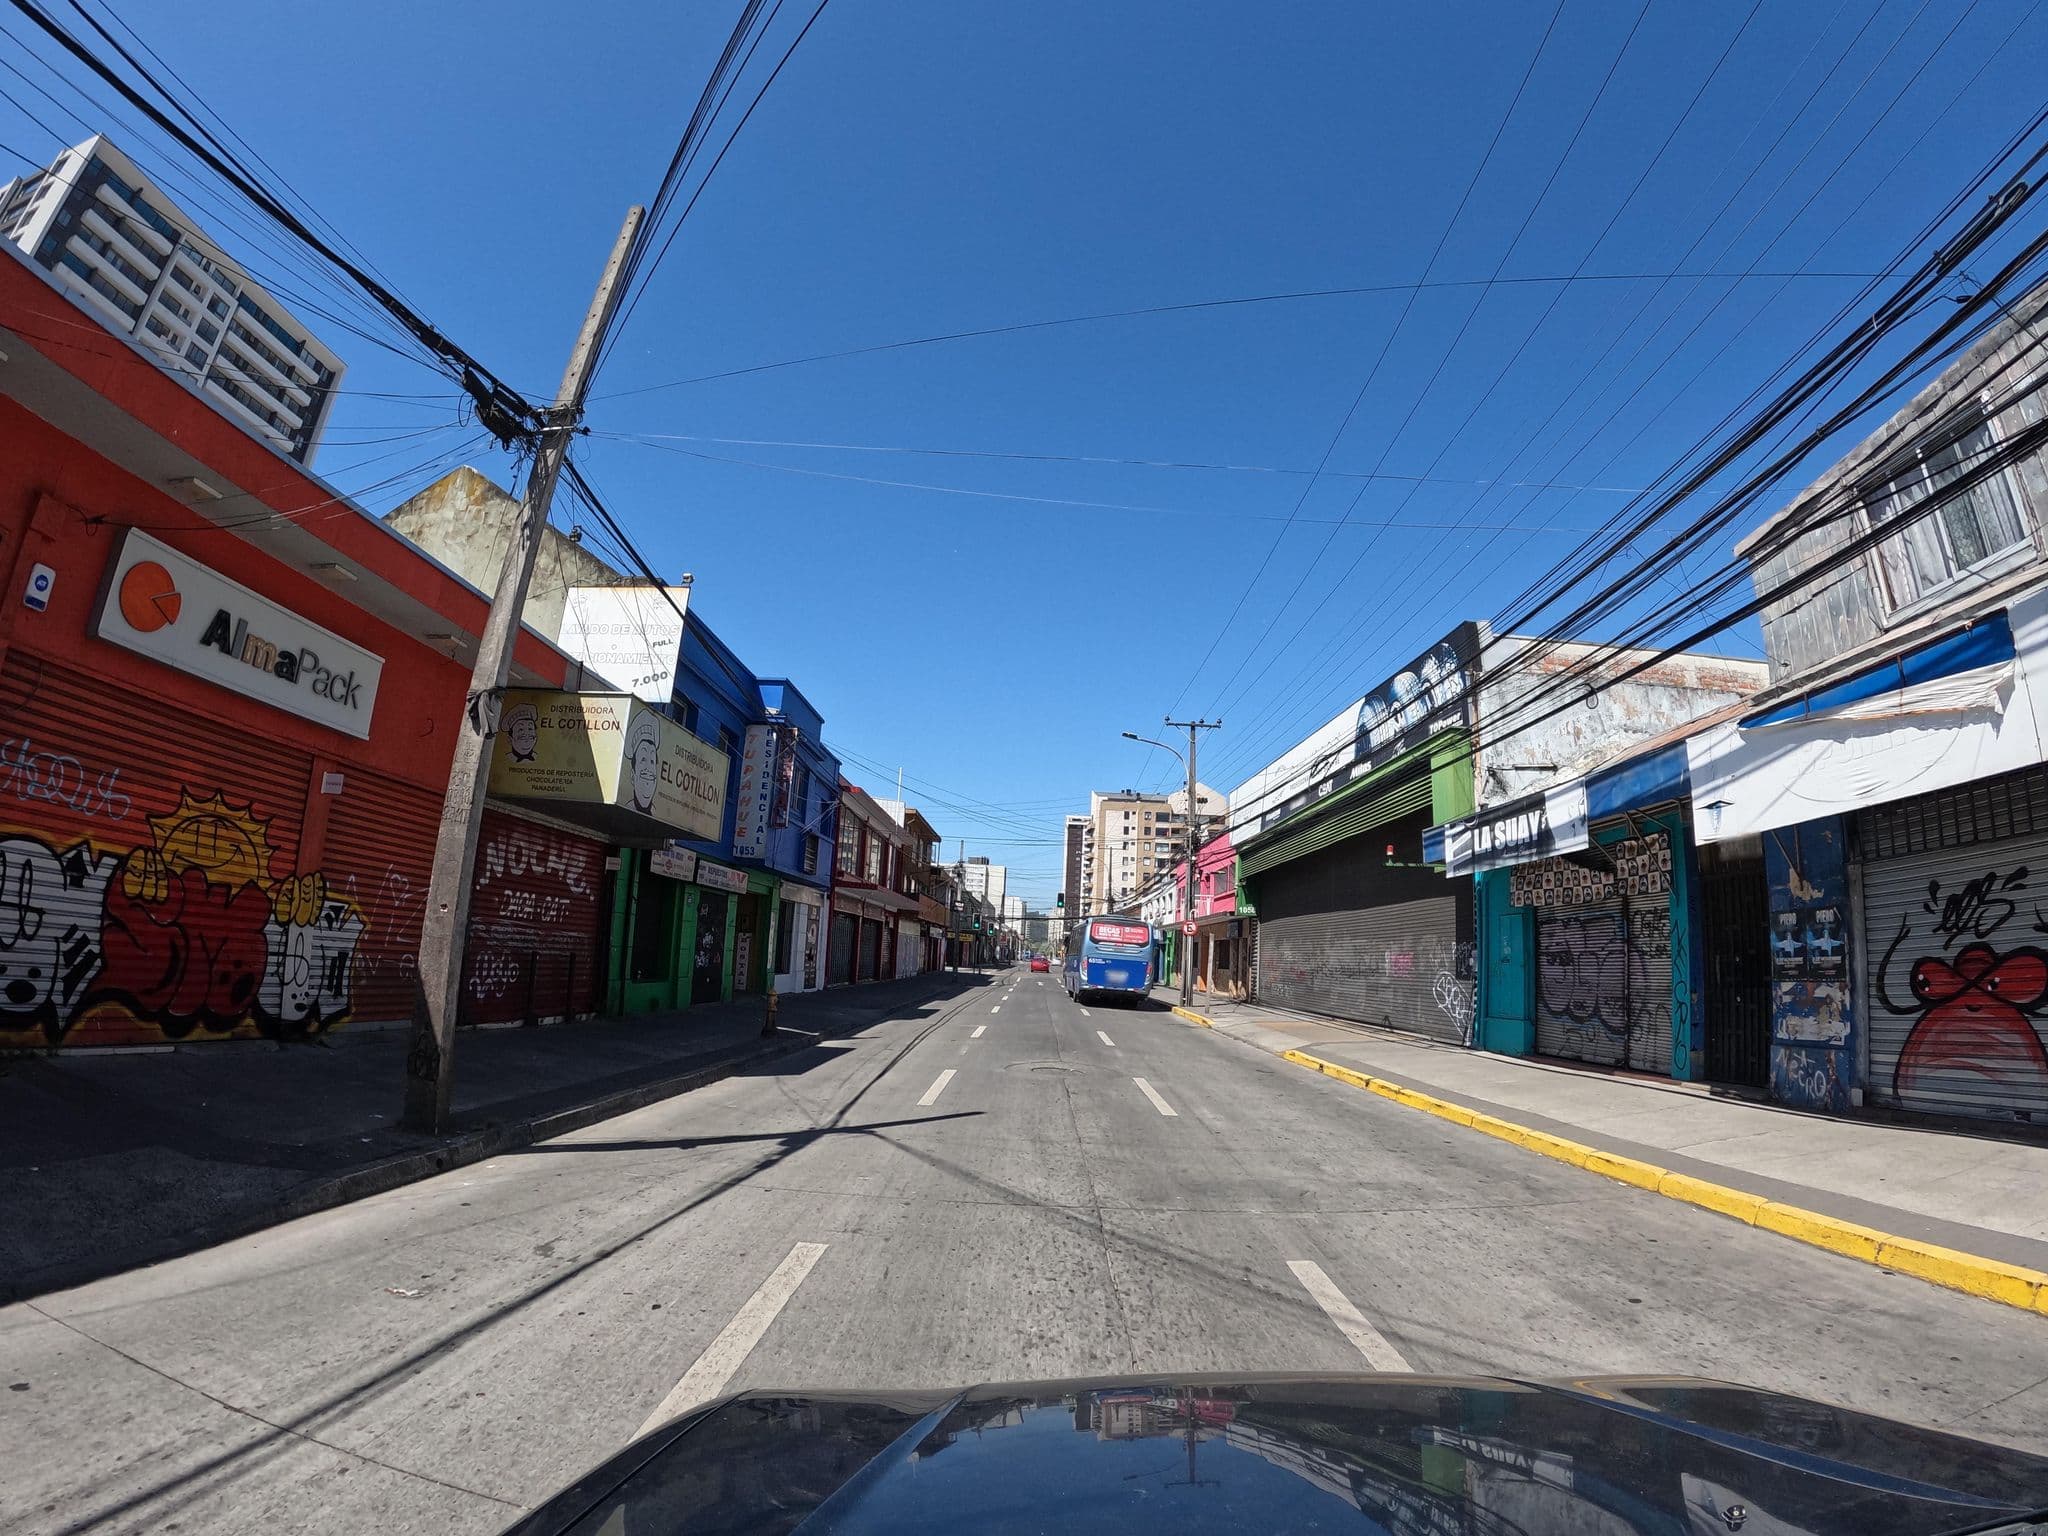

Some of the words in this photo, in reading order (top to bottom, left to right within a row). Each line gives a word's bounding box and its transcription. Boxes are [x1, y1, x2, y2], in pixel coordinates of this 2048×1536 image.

[652, 638, 674, 648] FULL
[199, 608, 363, 710] AlmaPack
[631, 671, 669, 688] 7.000
[550, 704, 615, 715] DISTRIBUIDORA
[540, 717, 555, 729] EL
[558, 718, 621, 731] COTILLON
[674, 744, 714, 774] DISTRIBUIDORA
[508, 767, 546, 776] PRODUCTOS
[660, 760, 673, 785] EL
[676, 768, 721, 806] COTILLON
[1473, 825, 1493, 853] LA
